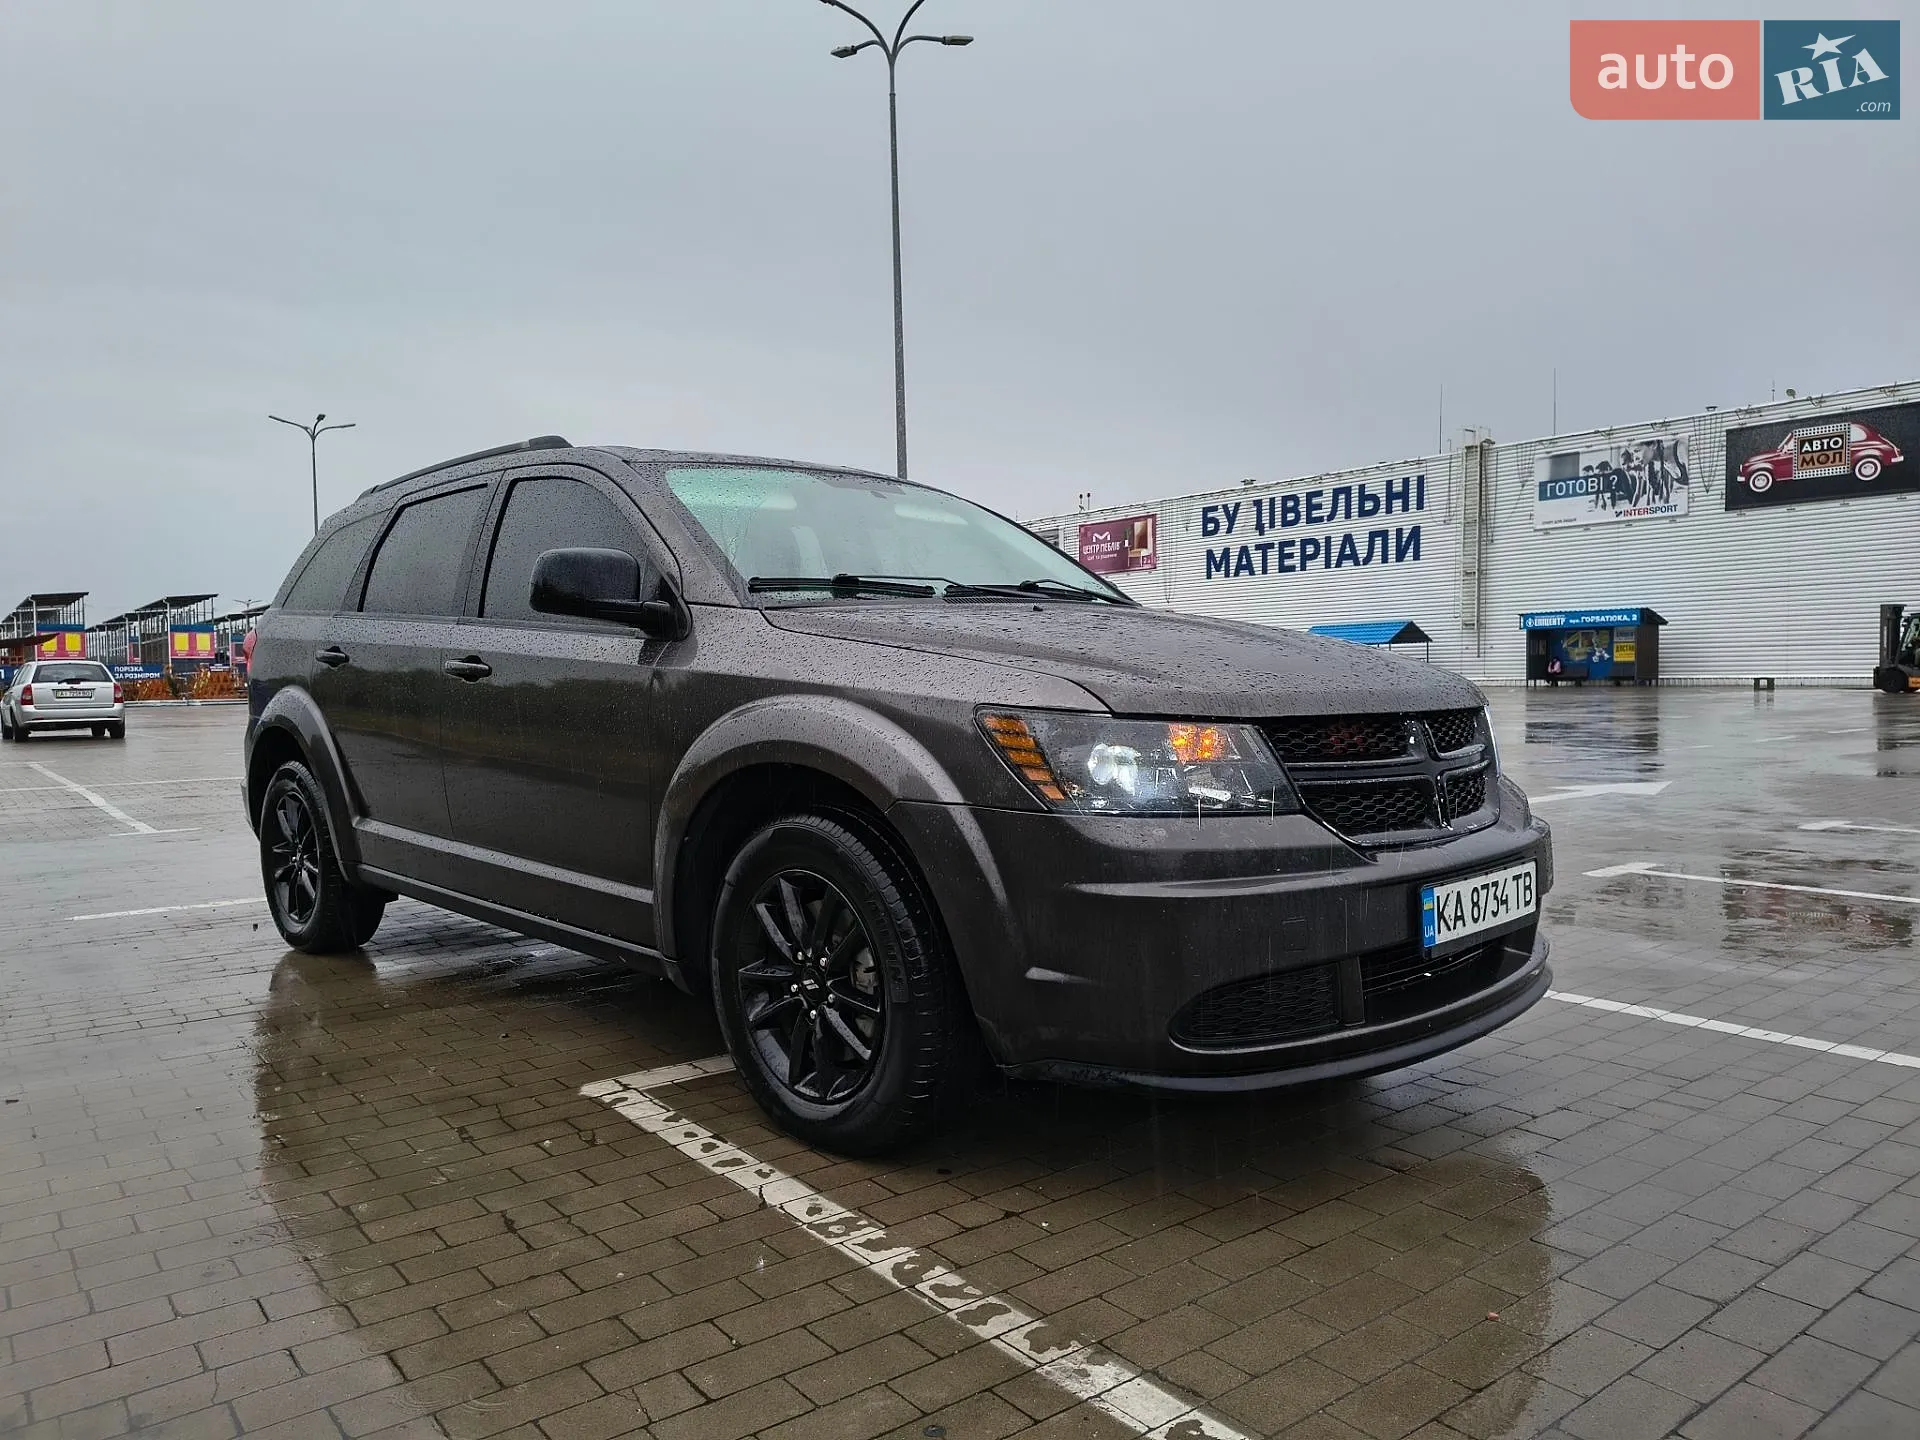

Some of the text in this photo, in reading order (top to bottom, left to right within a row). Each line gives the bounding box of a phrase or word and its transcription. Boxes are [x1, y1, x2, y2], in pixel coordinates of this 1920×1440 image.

[1801, 437, 1843, 453] АВТО
[1800, 451, 1843, 468] МОЛ
[1546, 477, 1604, 497] ГОТОВІ
[1623, 504, 1679, 518] INTERSPORT
[1206, 525, 1422, 580] МАТЕРІАЛИ
[1436, 871, 1533, 935] KA 8734 TB
[1424, 926, 1435, 938] UA
